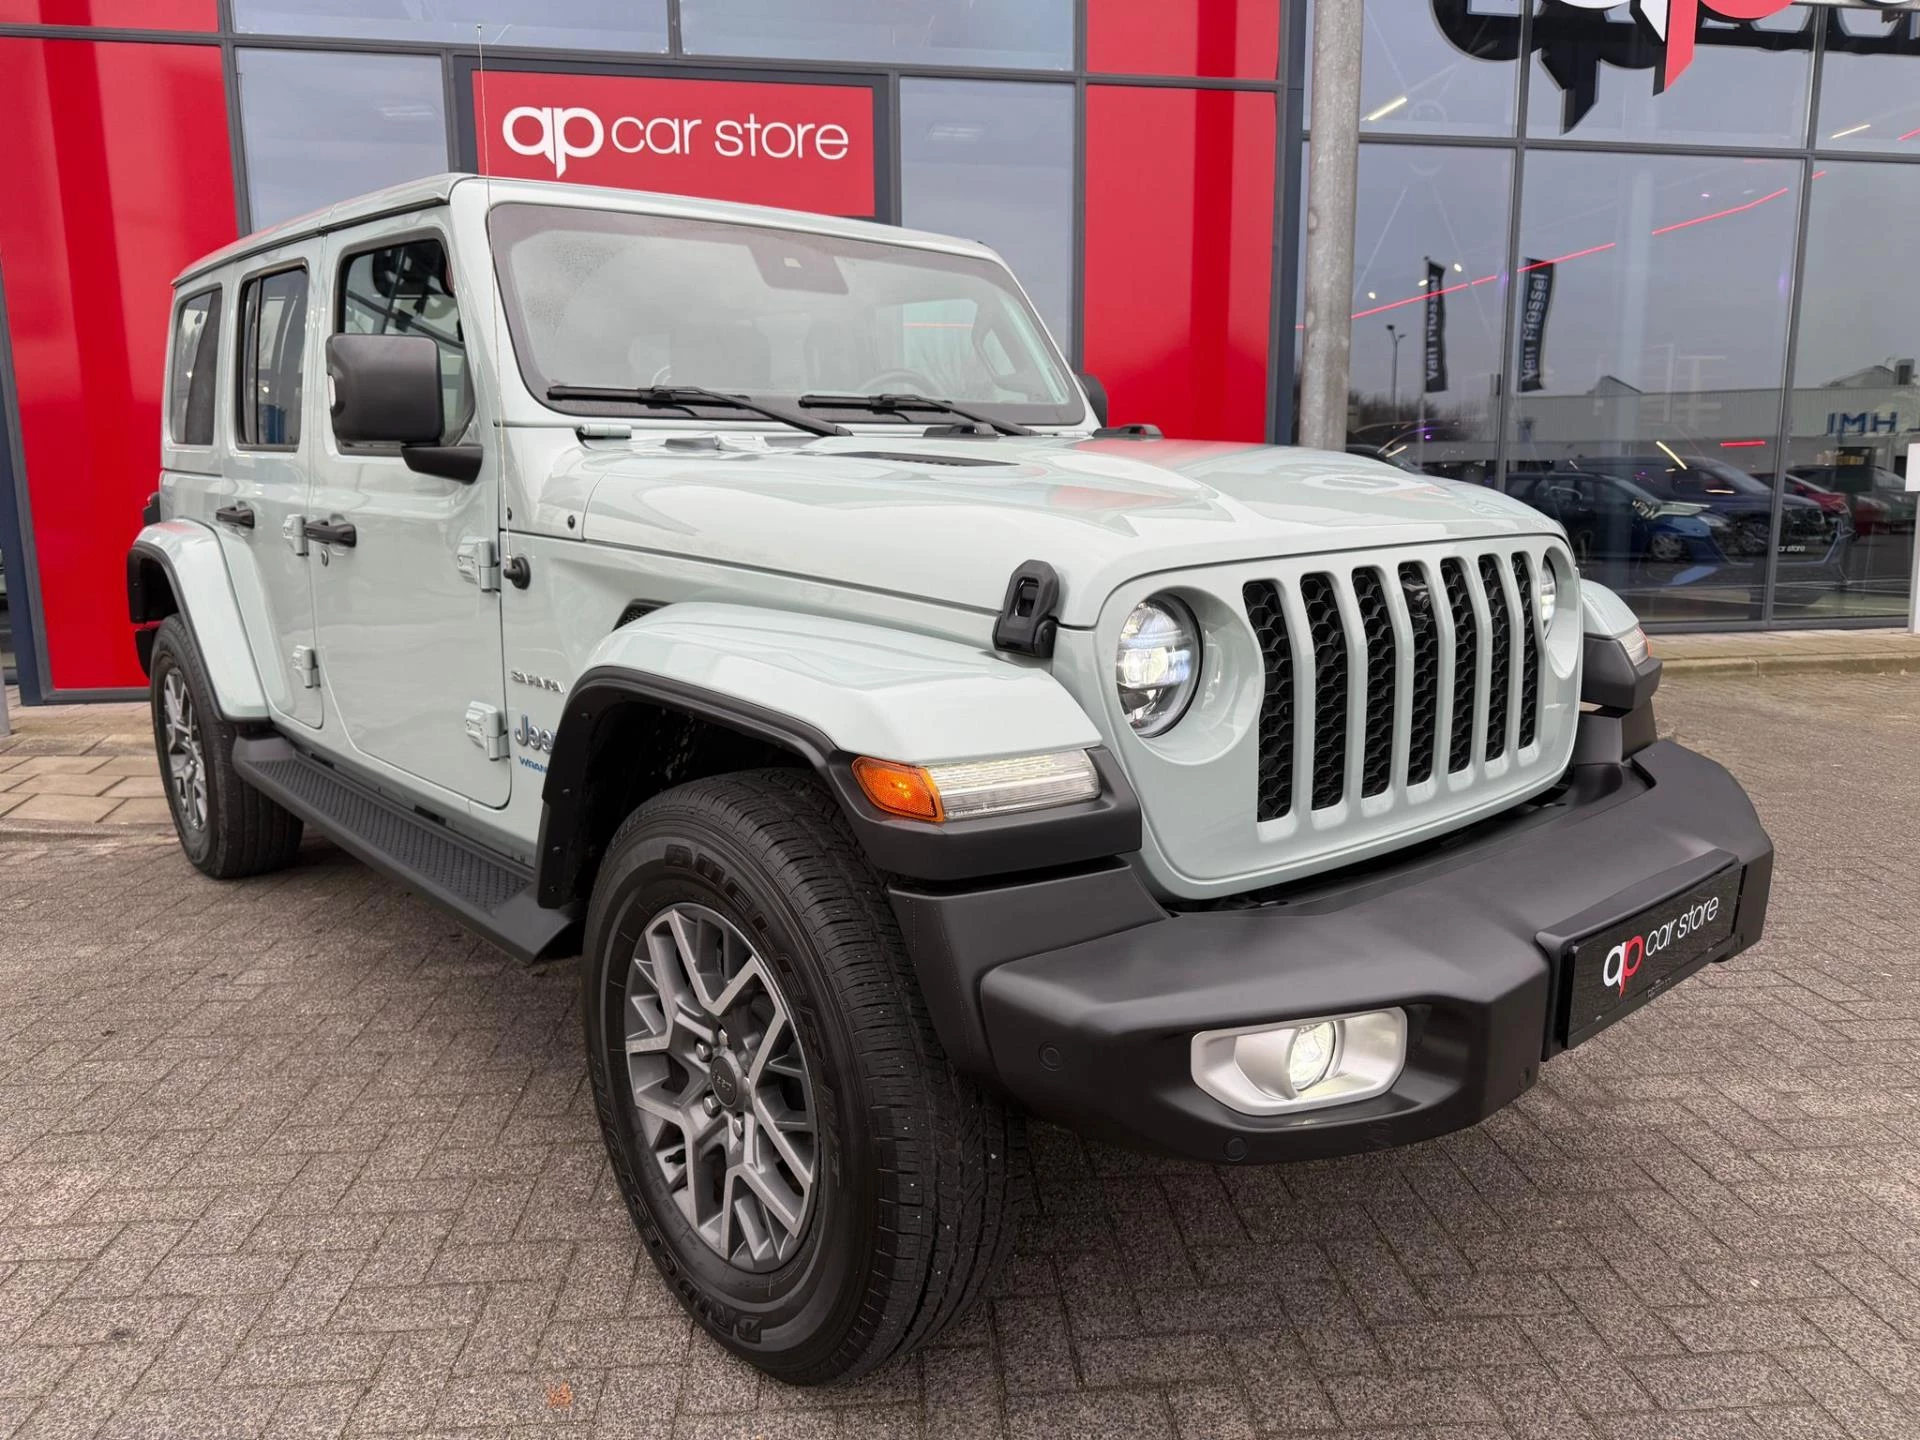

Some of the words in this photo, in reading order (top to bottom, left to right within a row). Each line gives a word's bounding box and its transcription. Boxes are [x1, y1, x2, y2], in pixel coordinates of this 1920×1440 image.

[502, 105, 604, 178] ap
[610, 115, 702, 155] car
[714, 112, 849, 160] store
[514, 713, 557, 755] Jee
[1603, 935, 1644, 999] ap
[1646, 919, 1678, 956] car
[1677, 896, 1719, 939] store
